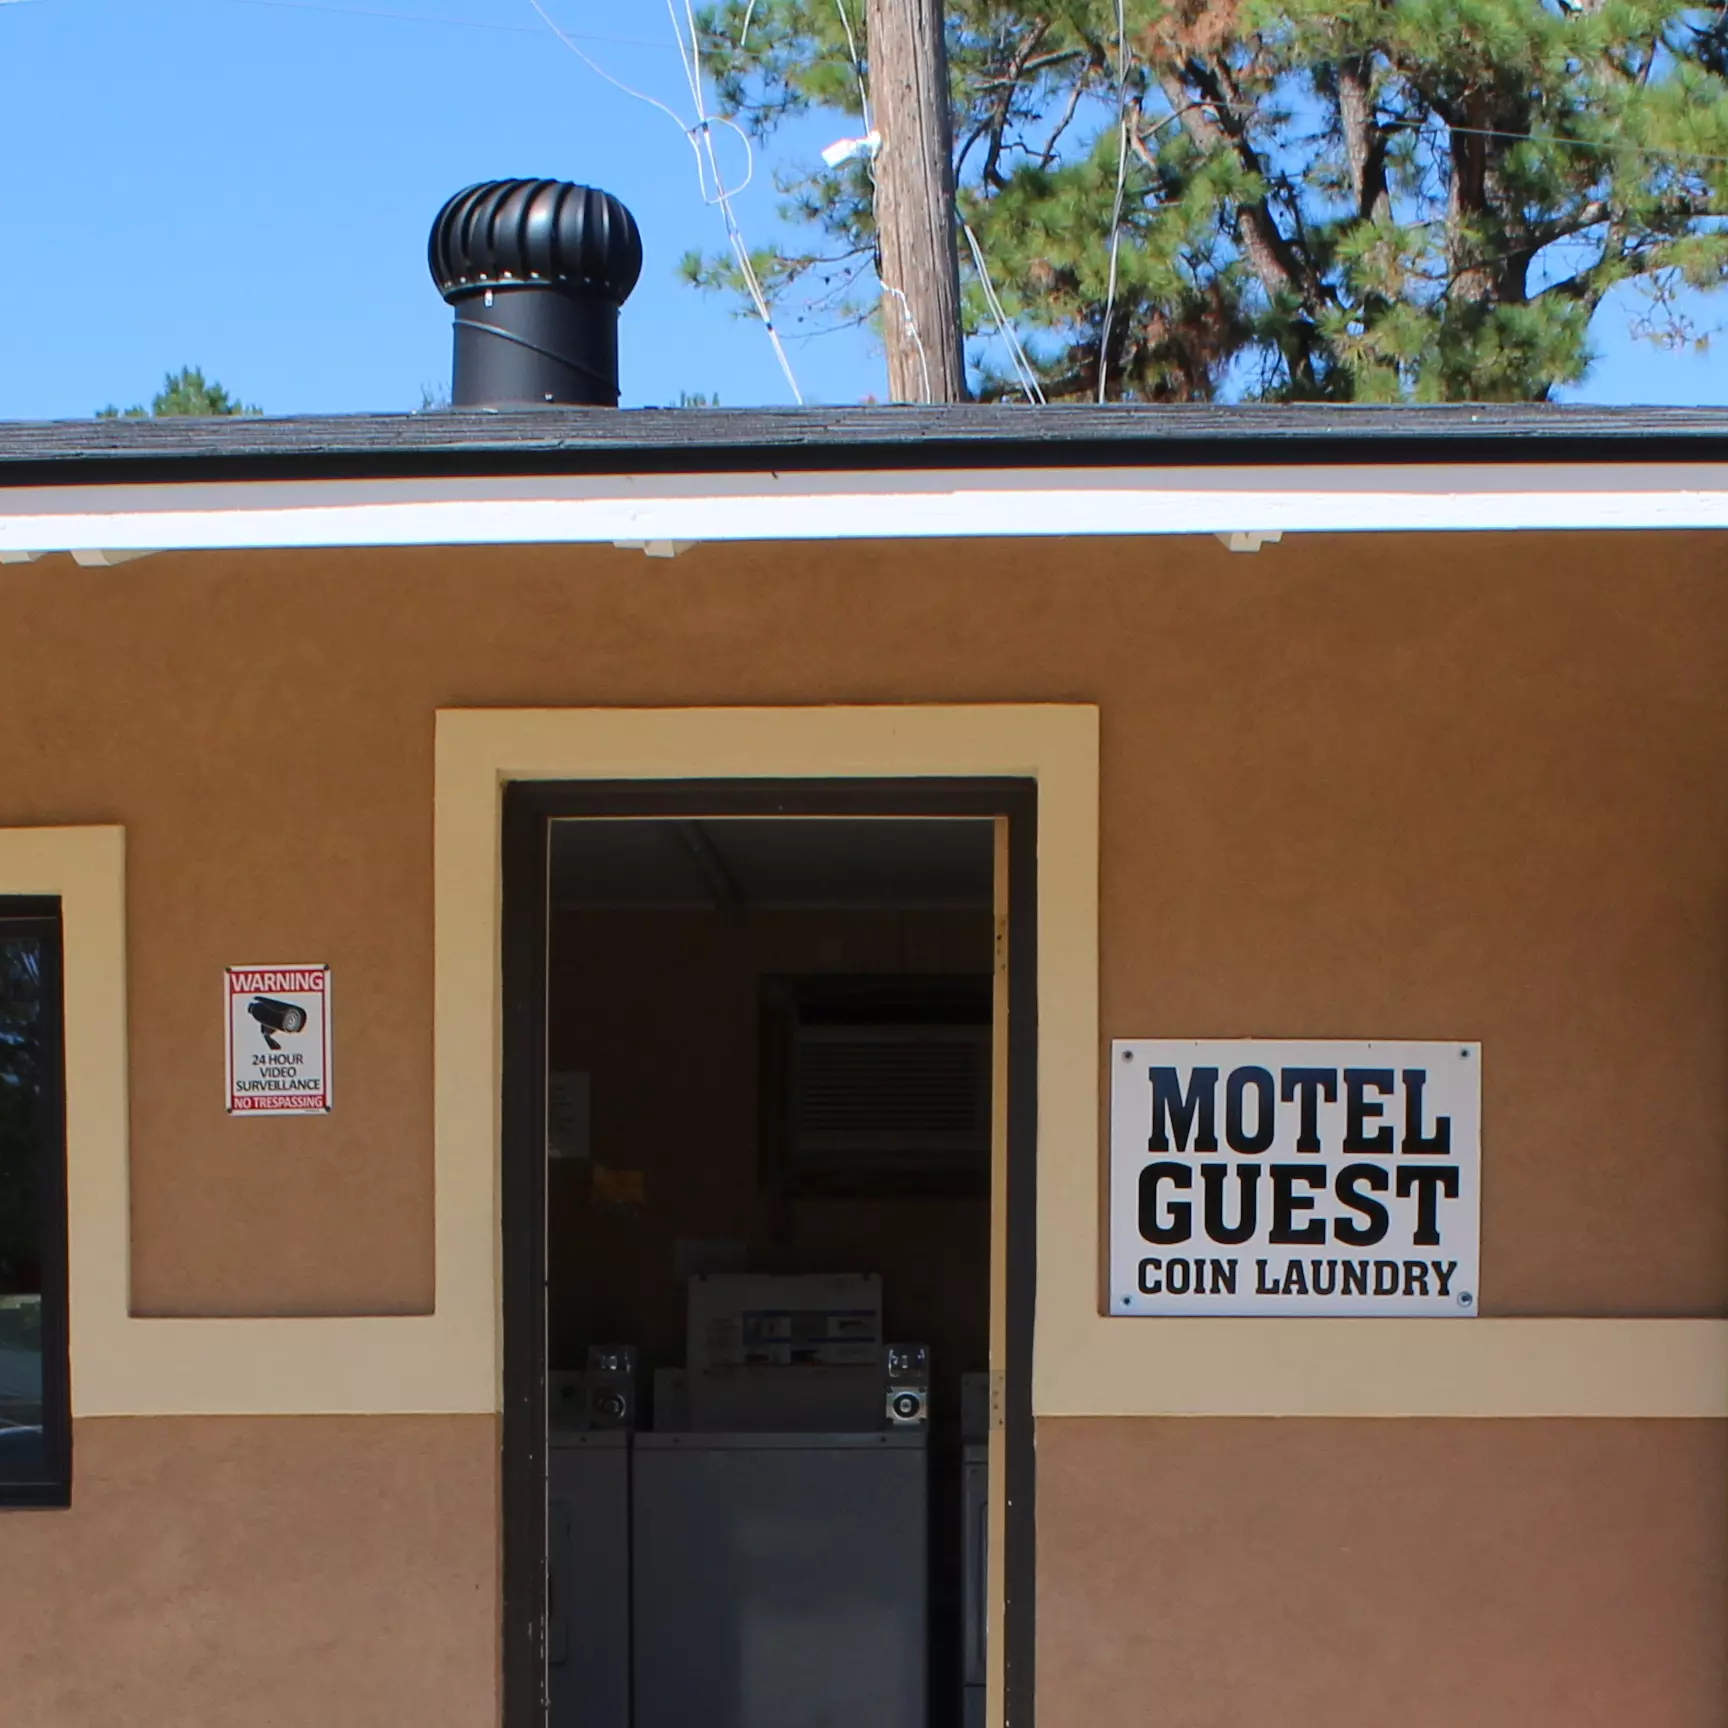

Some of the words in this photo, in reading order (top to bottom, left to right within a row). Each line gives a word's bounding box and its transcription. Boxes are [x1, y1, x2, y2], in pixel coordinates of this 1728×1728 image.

[231, 971, 324, 992] WARNING
[252, 1054, 266, 1066] 24
[269, 1054, 304, 1065] HOUR
[260, 1067, 297, 1078] VIDEO
[236, 1079, 320, 1092] SURVEILLANCE
[234, 1097, 251, 1109] NO
[254, 1096, 323, 1108] TRESPASSING
[1148, 1065, 1451, 1155] MOTEL
[1138, 1161, 1460, 1247] GUEST
[1138, 1257, 1238, 1295] COIN
[1256, 1259, 1458, 1297] LAUNDRY
